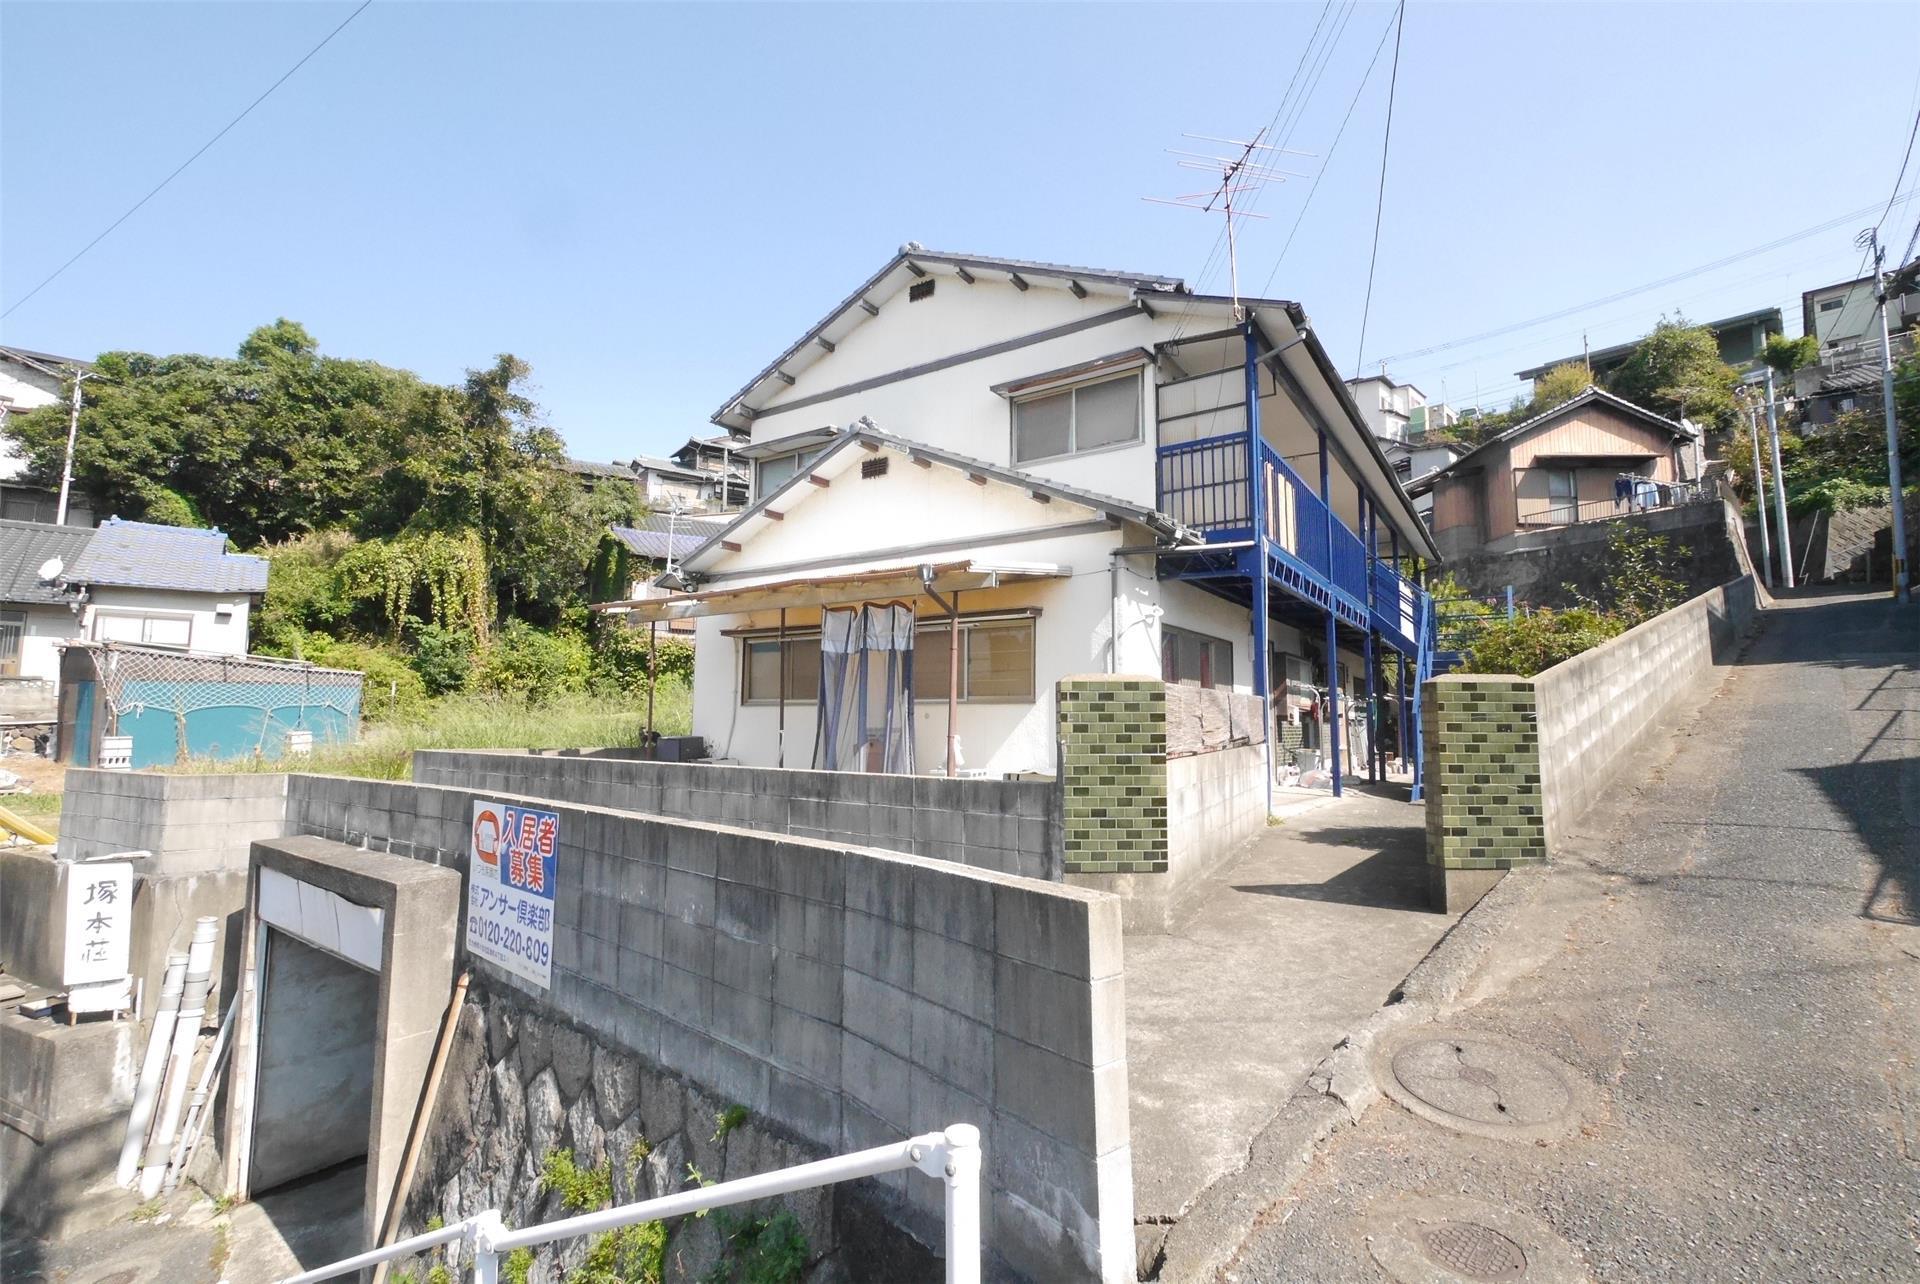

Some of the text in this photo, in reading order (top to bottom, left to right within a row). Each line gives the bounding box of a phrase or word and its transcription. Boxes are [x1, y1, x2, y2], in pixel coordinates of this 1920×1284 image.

[502, 812, 556, 857] 入居者
[509, 848, 544, 891] 募集
[480, 887, 550, 933] アンサー倶楽部
[478, 916, 549, 966] 0120-220-809
